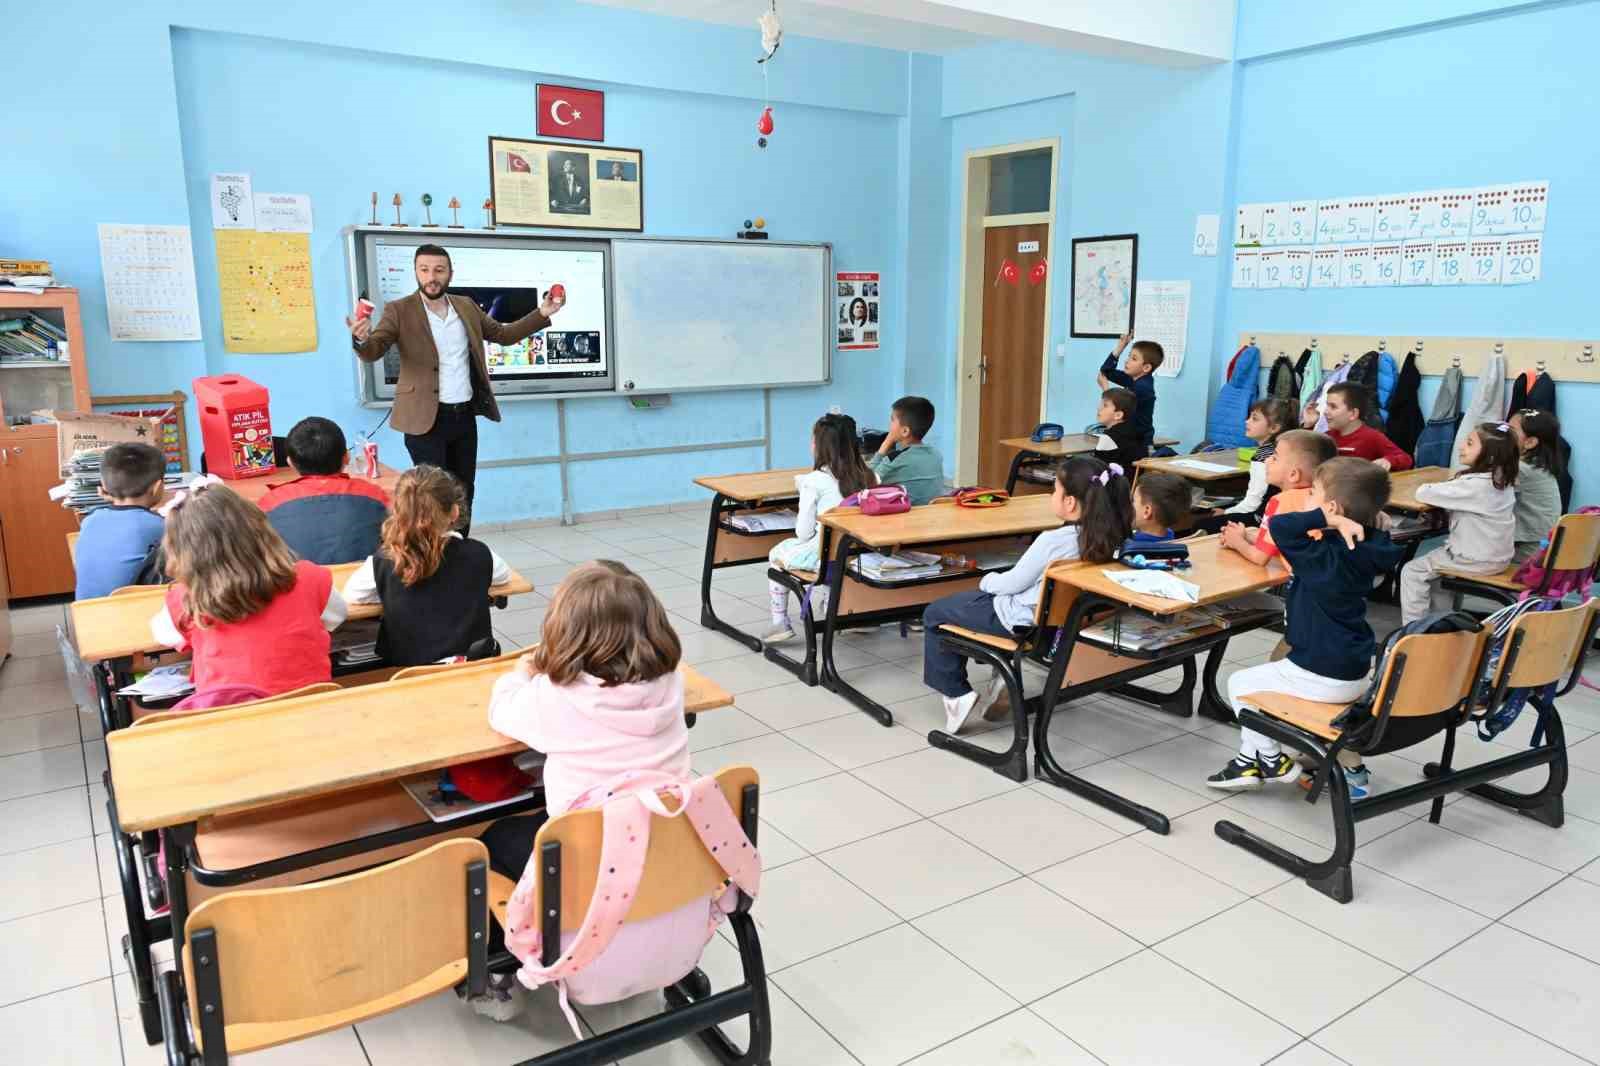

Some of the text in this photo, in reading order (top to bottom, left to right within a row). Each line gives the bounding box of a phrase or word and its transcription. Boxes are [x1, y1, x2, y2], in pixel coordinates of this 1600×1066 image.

[1266, 221, 1276, 238] 2
[1291, 220, 1302, 237] 3
[1319, 220, 1329, 235] 4
[1346, 217, 1358, 233] 5
[1378, 215, 1389, 232] 6
[1409, 212, 1419, 230] 7
[1440, 211, 1451, 228] 8
[1476, 208, 1487, 226] 9
[1511, 205, 1533, 223] 10
[1240, 256, 1534, 281] 11 12 13 14 15 16 17 18 19 20
[233, 412, 250, 422] ATIK
